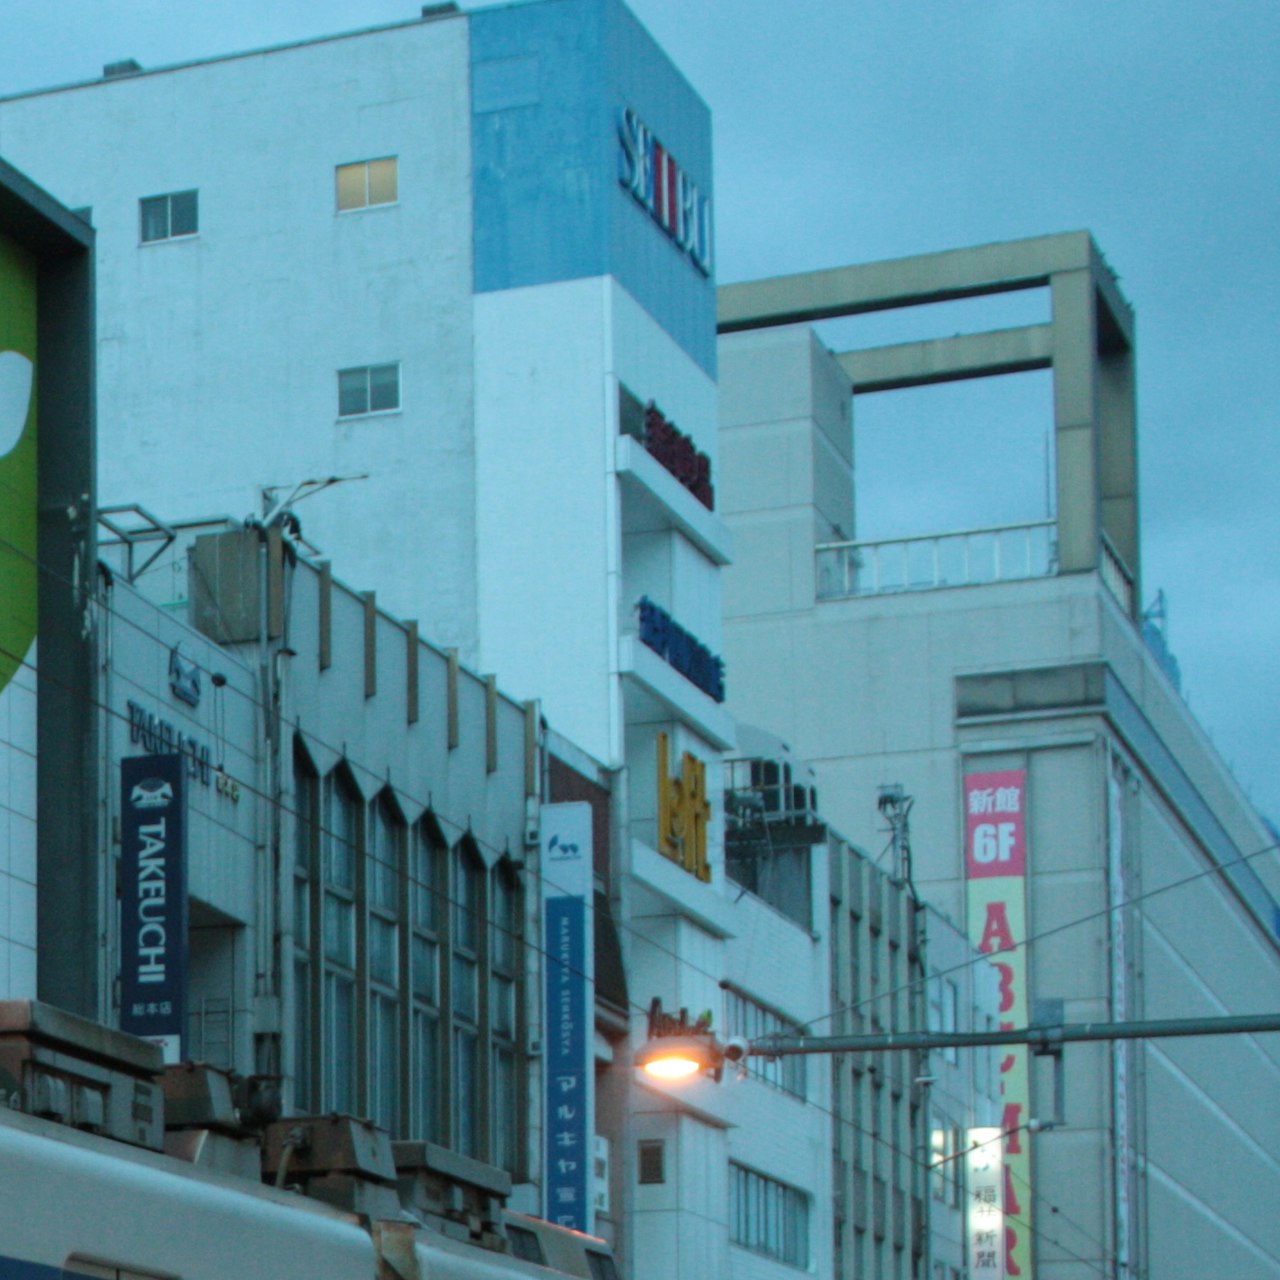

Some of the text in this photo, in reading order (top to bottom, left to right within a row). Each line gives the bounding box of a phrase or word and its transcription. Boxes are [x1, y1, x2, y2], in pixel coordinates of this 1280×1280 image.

[968, 787, 1020, 815] 新館
[973, 823, 1017, 864] 6F
[138, 816, 167, 984] TAKEUCHI
